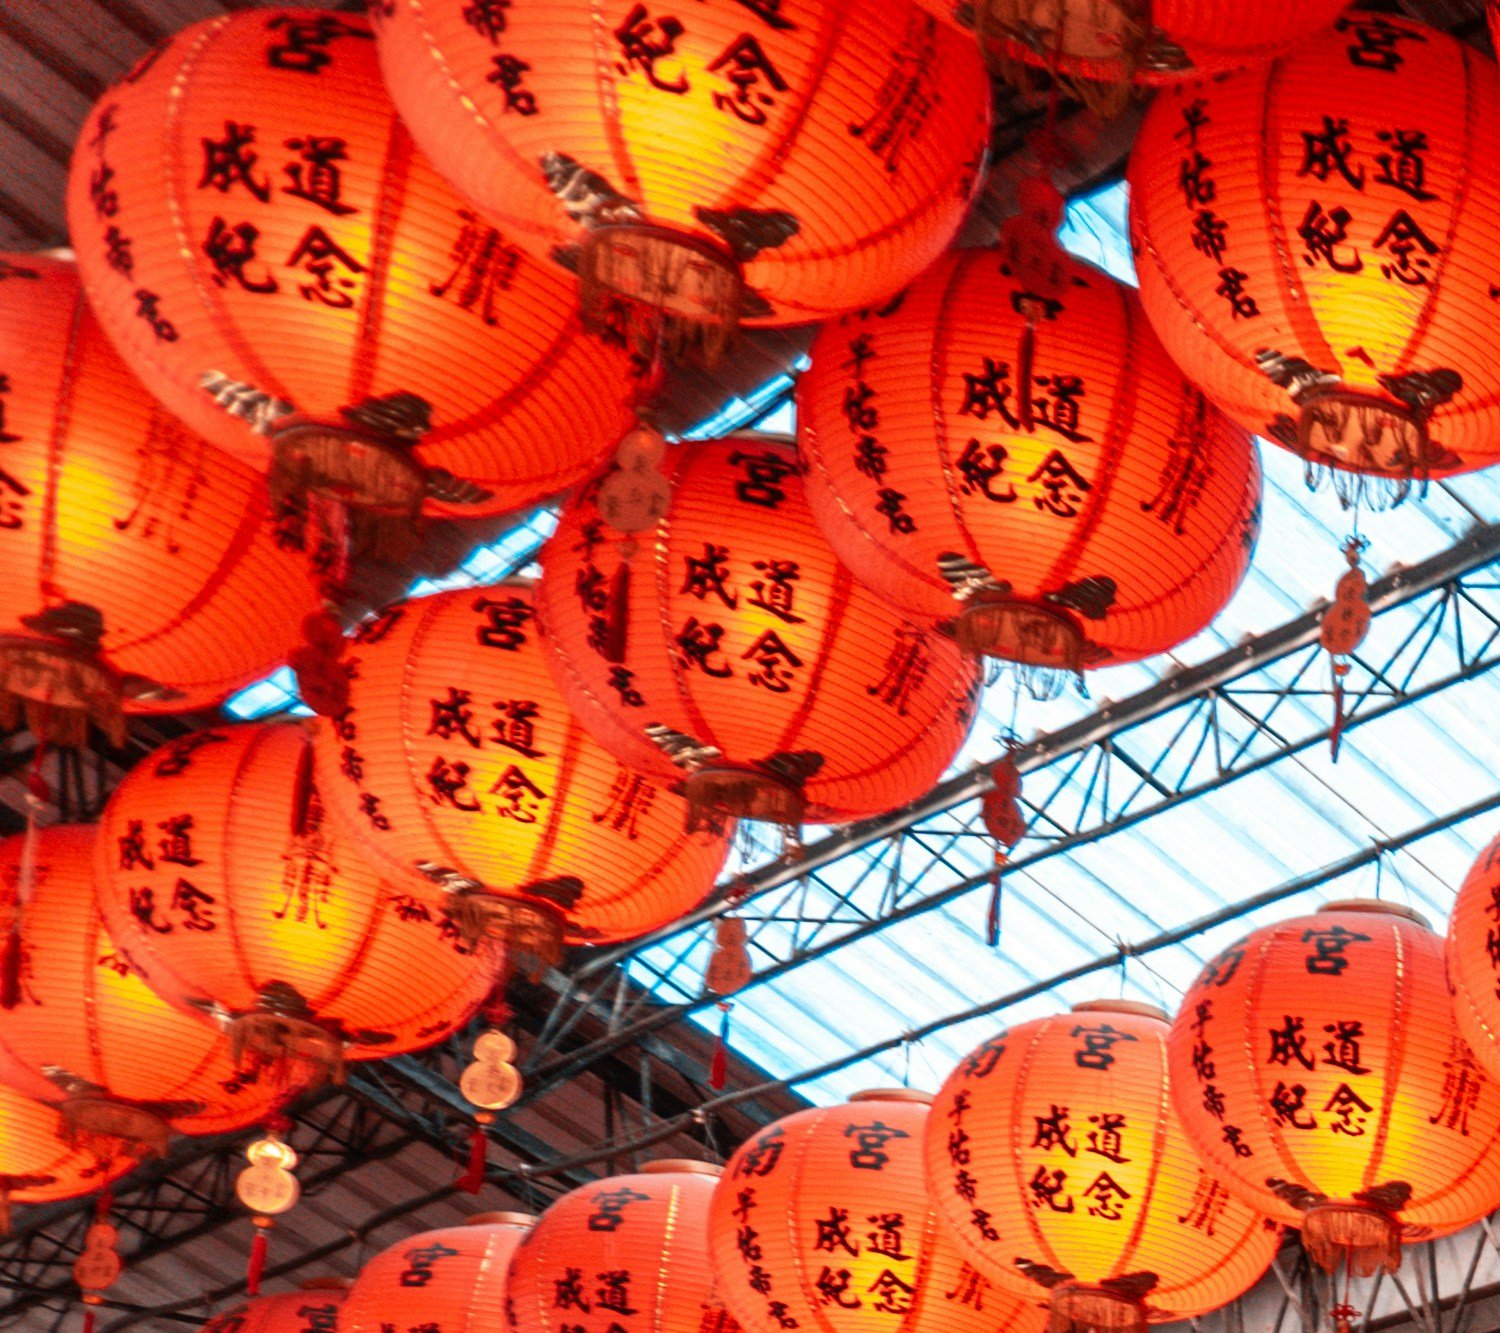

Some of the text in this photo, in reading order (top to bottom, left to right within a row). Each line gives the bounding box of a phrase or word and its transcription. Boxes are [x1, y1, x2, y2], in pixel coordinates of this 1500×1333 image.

[613, 3, 791, 126] 紀念
[1334, 8, 1427, 76] 宮
[198, 120, 358, 216] 成道
[1299, 116, 1439, 205] 成道
[1173, 102, 1262, 322] 孚佑帝君
[1297, 202, 1441, 288] 紀念
[202, 216, 366, 308] 紀念
[841, 332, 918, 536] 孚佑帝君
[959, 356, 1094, 444] 成道
[728, 450, 809, 508] 宮
[955, 439, 1091, 519] 紀念
[678, 541, 802, 625] 成道
[475, 597, 536, 651] 宮
[675, 616, 803, 694] 紀念
[426, 686, 547, 759] 成道
[425, 755, 547, 825] 紀念
[118, 814, 202, 870] 成道
[1189, 999, 1253, 1159] 孚佑帝君
[1266, 1016, 1370, 1076] 成道
[1029, 1105, 1133, 1164] 成道
[1267, 1082, 1375, 1138] 紀念
[947, 1089, 1000, 1242] 孚佑帝君
[1028, 1167, 1135, 1223] 紀念
[732, 1186, 799, 1330] 孚佑帝君
[813, 1207, 915, 1263] 成道
[553, 1266, 640, 1316] 成道
[815, 1265, 917, 1316] 紀念
